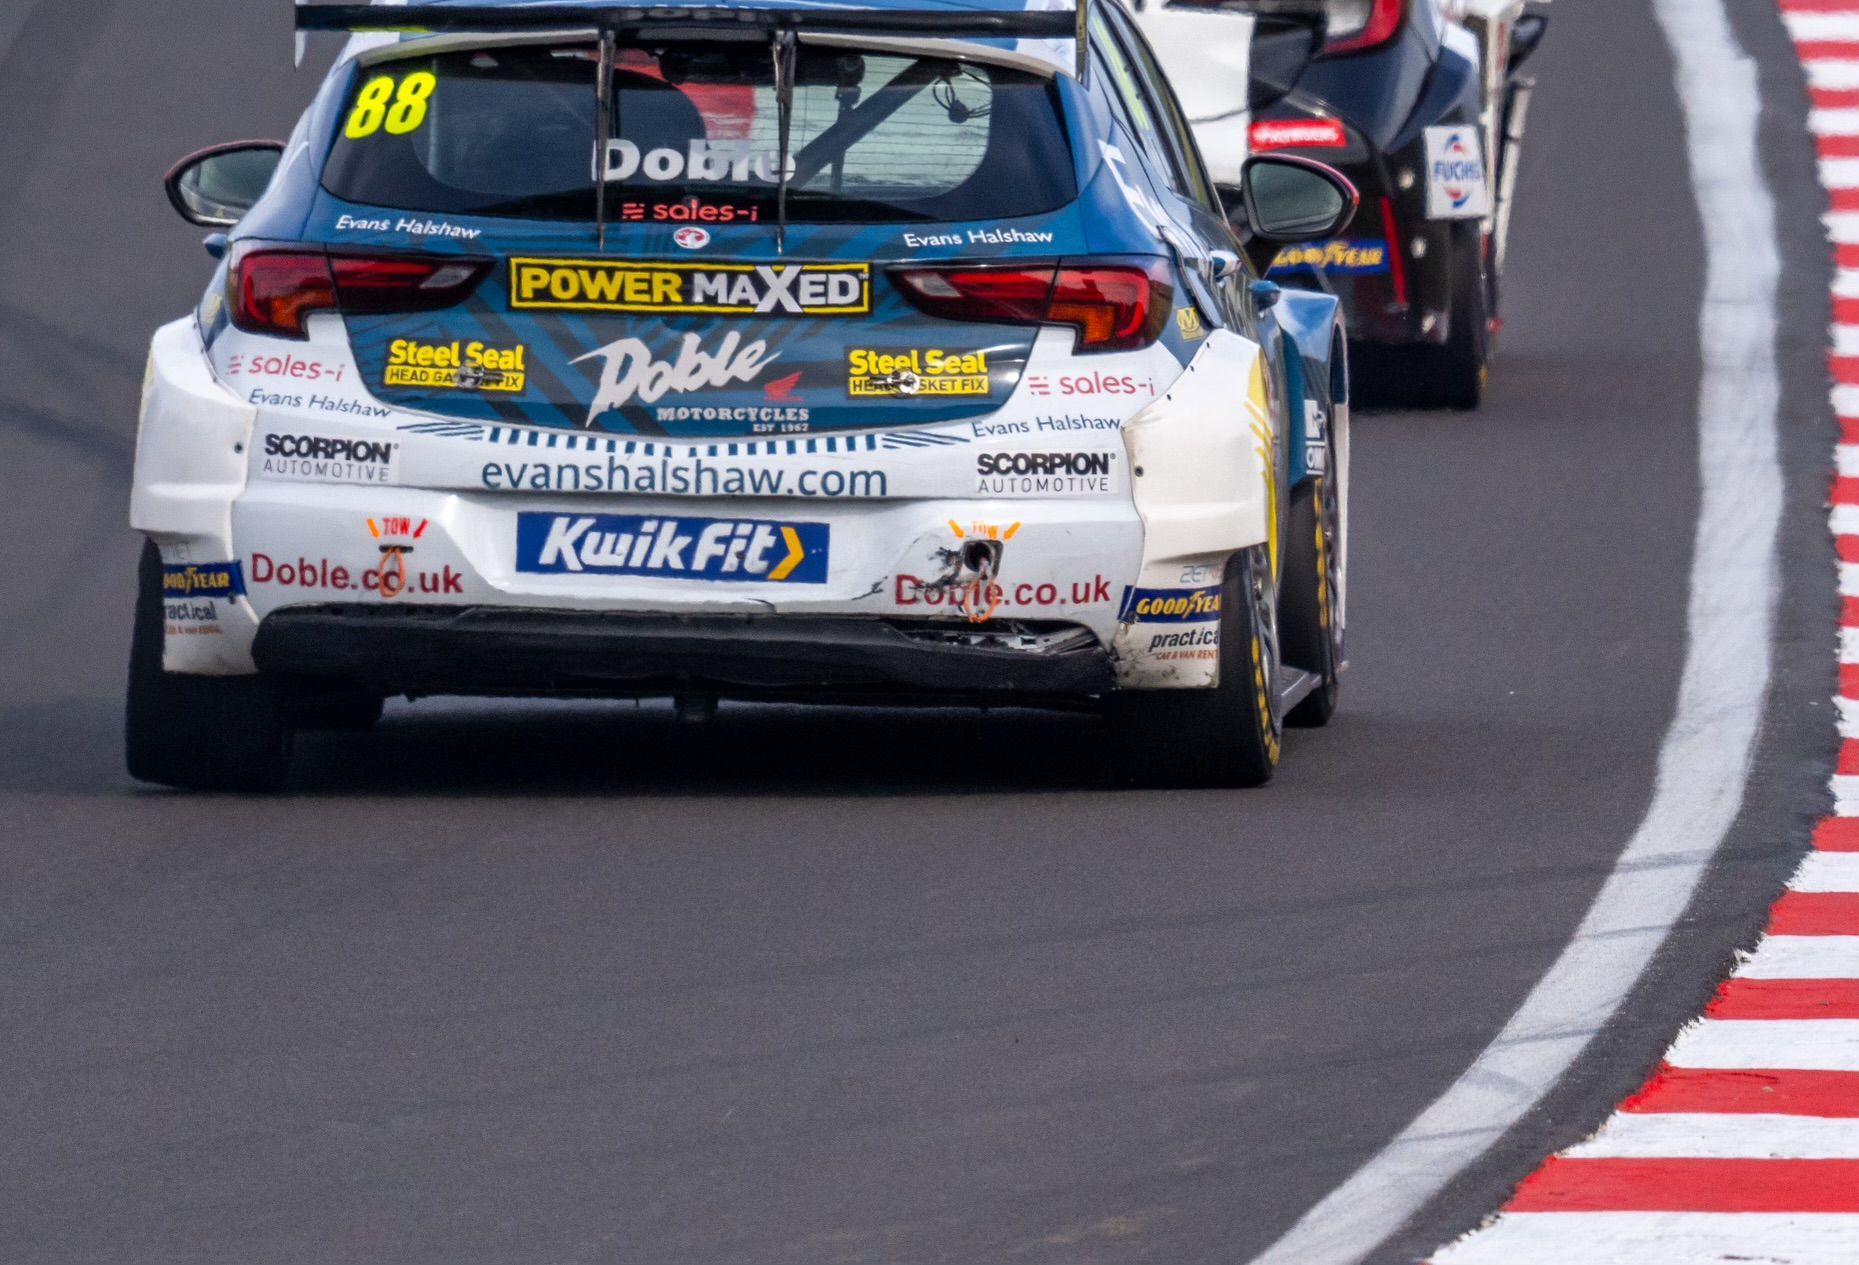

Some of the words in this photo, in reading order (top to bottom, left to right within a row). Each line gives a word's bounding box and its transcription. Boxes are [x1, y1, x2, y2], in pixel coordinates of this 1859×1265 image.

[345, 71, 436, 139] 88
[591, 138, 797, 182] Doble
[652, 199, 759, 222] sales-i
[335, 214, 391, 232] Evans
[395, 217, 482, 240] Halshaw
[903, 232, 963, 248] Evans
[967, 228, 1053, 244] Halshaw
[520, 267, 683, 303] POWER
[692, 265, 861, 313] MAXED
[388, 338, 461, 368] Steel
[465, 341, 525, 371] Seal
[849, 349, 921, 375] Steel
[924, 349, 988, 374] Seal
[248, 354, 345, 382] sales-i
[389, 368, 429, 383] HEAD
[567, 331, 783, 428] Doble
[852, 379, 896, 393] HEA
[961, 378, 985, 391] FIX
[1059, 371, 1155, 396] sales-i
[250, 388, 302, 407] Evans
[308, 394, 391, 418] Halshaw
[656, 407, 810, 421] MOTORCYCLES
[972, 421, 1030, 437] Evans
[1036, 414, 1121, 432] Halshaw
[264, 434, 392, 464] SCORPION
[264, 459, 391, 482] AUTOMOTIVE
[482, 456, 888, 497] evanshalshaw.com
[977, 453, 1109, 475] SCORPION
[977, 478, 1109, 494] AUTOMOTIVE
[383, 517, 411, 535] TOW
[252, 553, 464, 593] Doble.co.uk
[1136, 590, 1222, 619] GOODYEA
